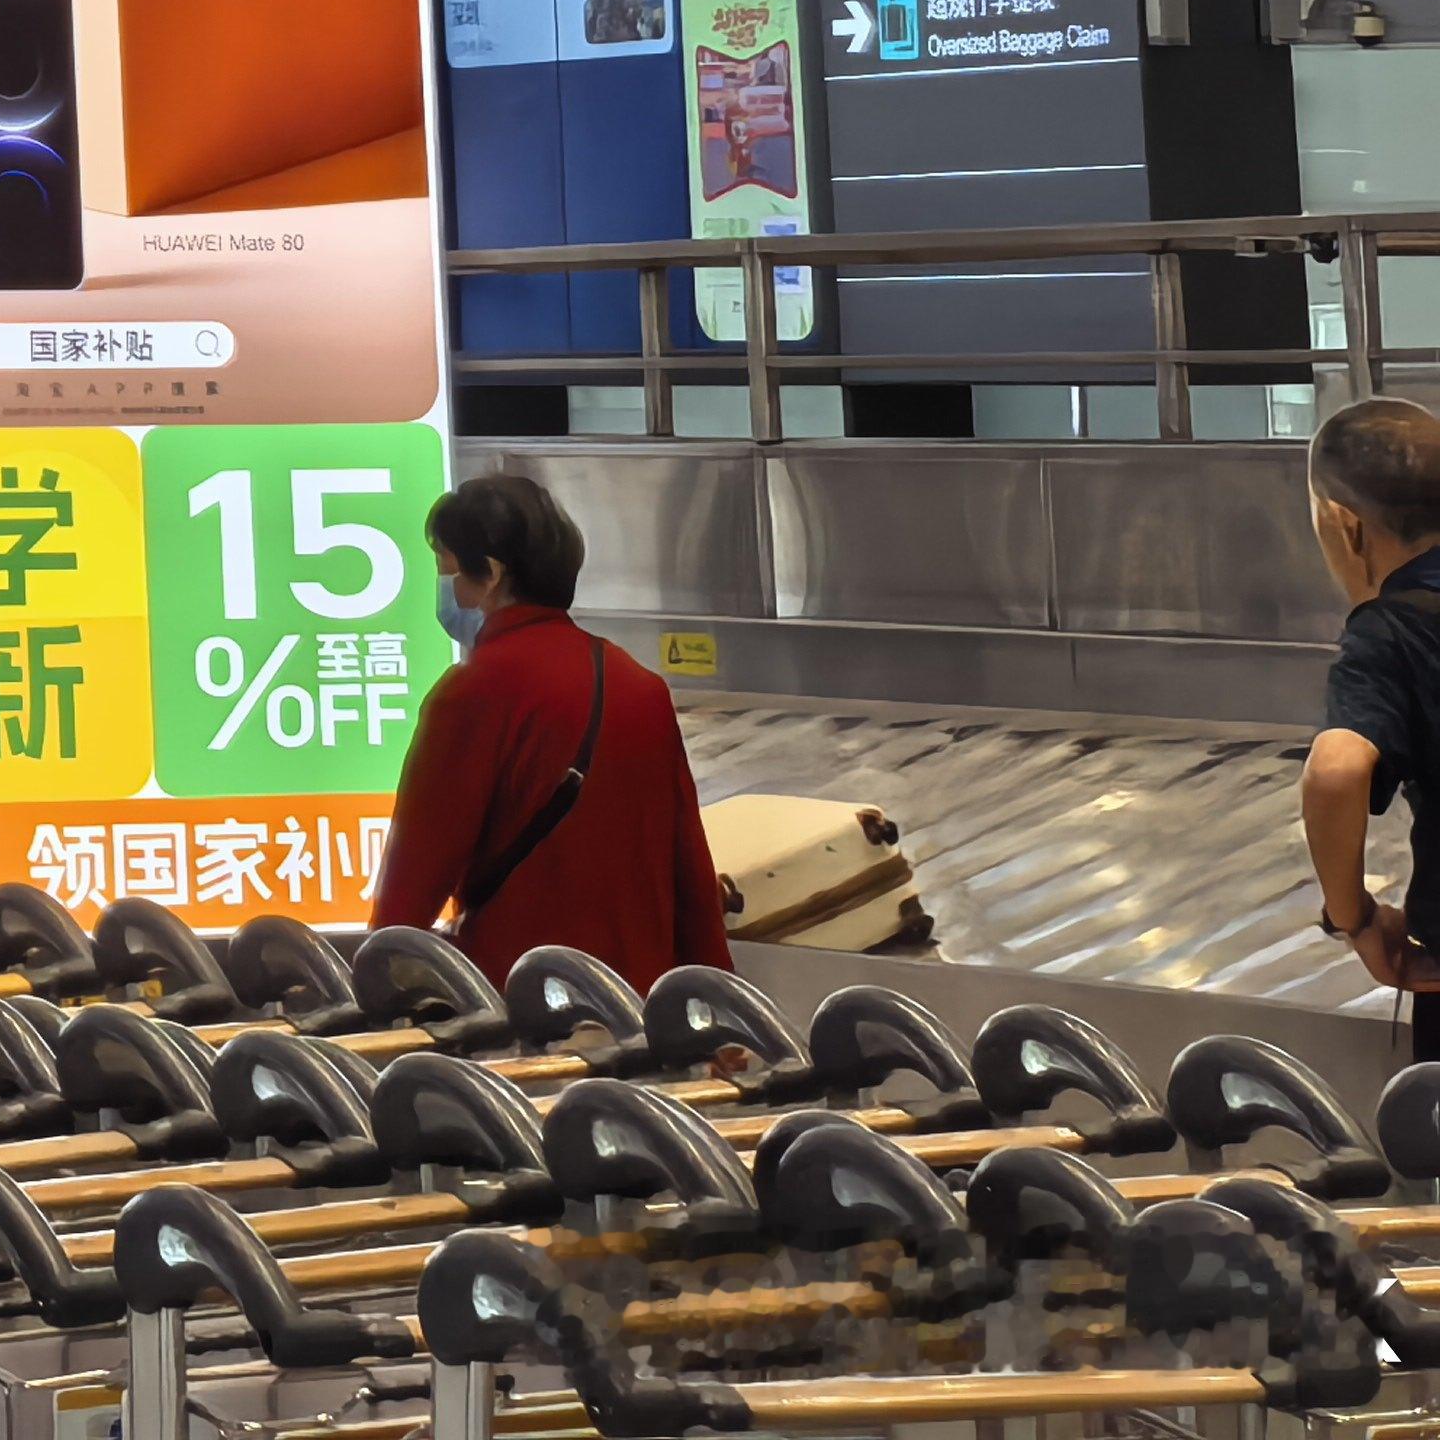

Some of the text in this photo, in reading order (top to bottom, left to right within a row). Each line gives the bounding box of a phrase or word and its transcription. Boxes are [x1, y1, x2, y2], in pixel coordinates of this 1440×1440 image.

[142, 233, 222, 252] HUAWEI
[229, 233, 276, 252] Mate
[29, 328, 154, 363] 国家补贴
[187, 467, 406, 620] 15
[315, 631, 409, 679] 至高
